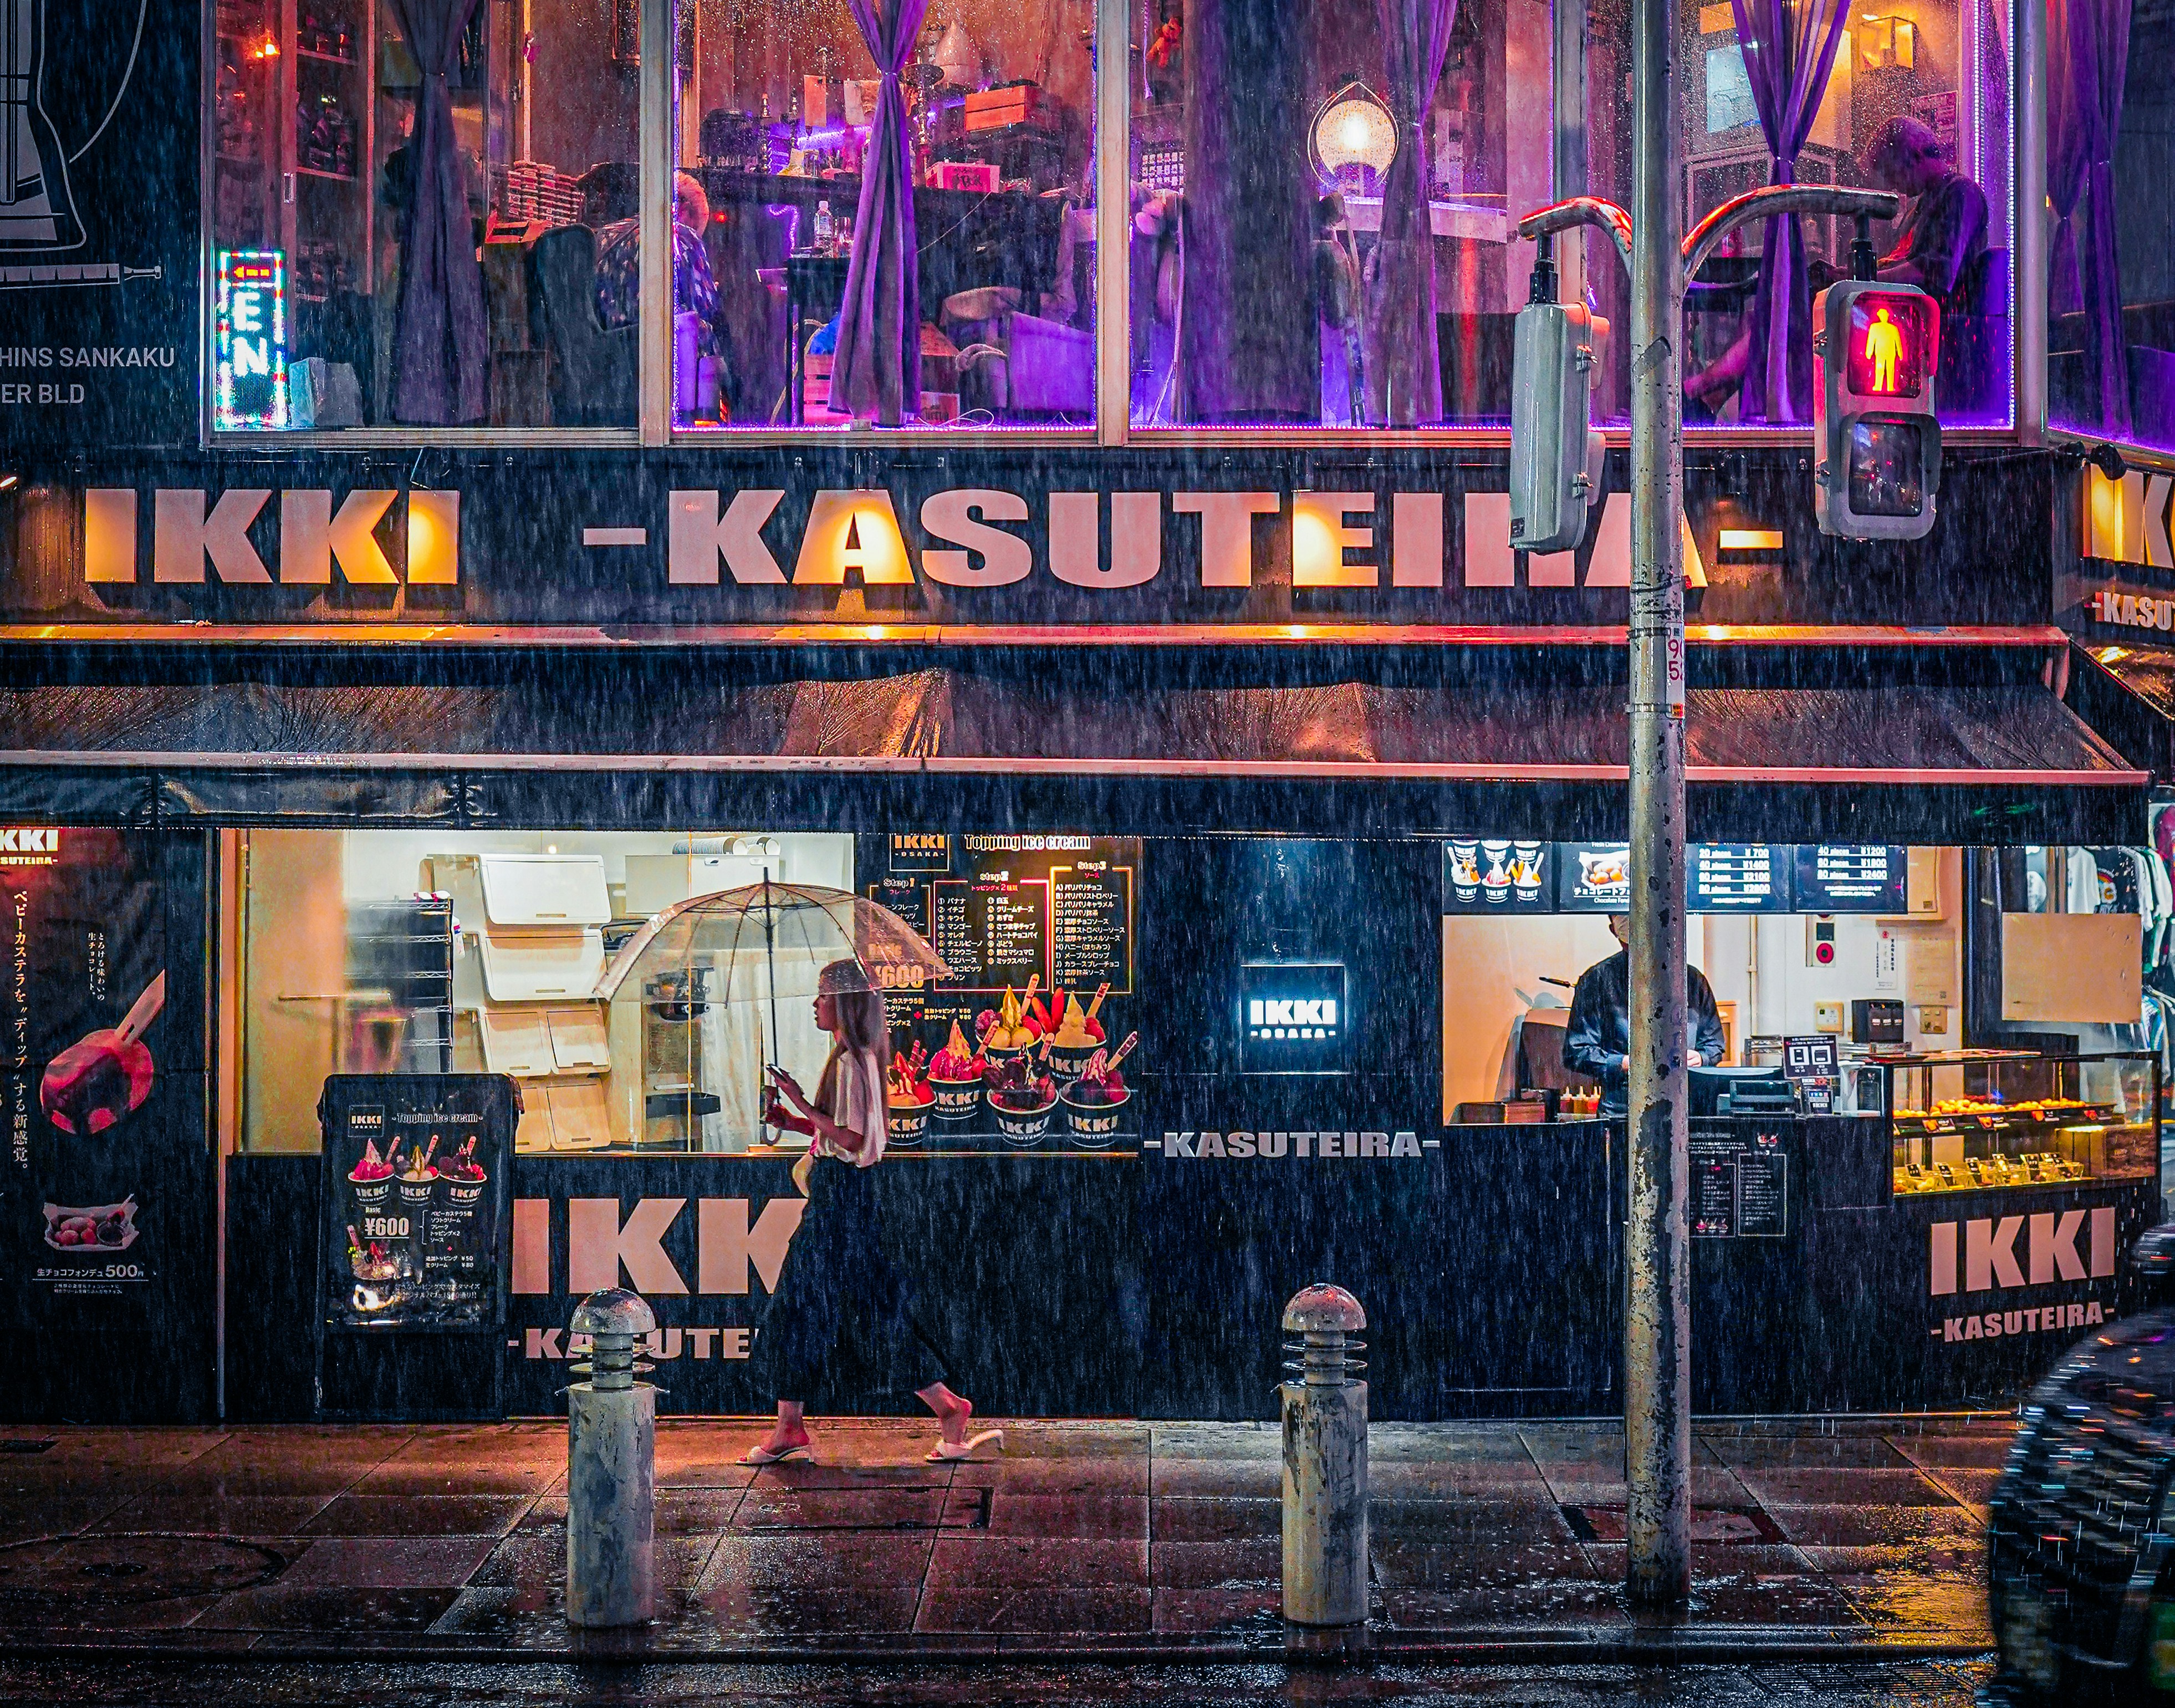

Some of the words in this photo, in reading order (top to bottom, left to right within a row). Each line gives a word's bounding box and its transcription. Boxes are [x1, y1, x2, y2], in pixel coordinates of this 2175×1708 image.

[59, 348, 174, 367] SANKAKU
[2, 384, 31, 403] ER
[39, 384, 83, 403] BLD
[85, 488, 459, 584] IKKI
[895, 835, 945, 849] IKKI
[965, 835, 1021, 850] Topping
[1046, 836, 1091, 850] cream
[1250, 1000, 1336, 1024] IKKI
[351, 1115, 382, 1124] IKKI
[1068, 1113, 1118, 1132] IKKI
[365, 1218, 409, 1236] ¥600
[1931, 1207, 2115, 1296] IKKI
